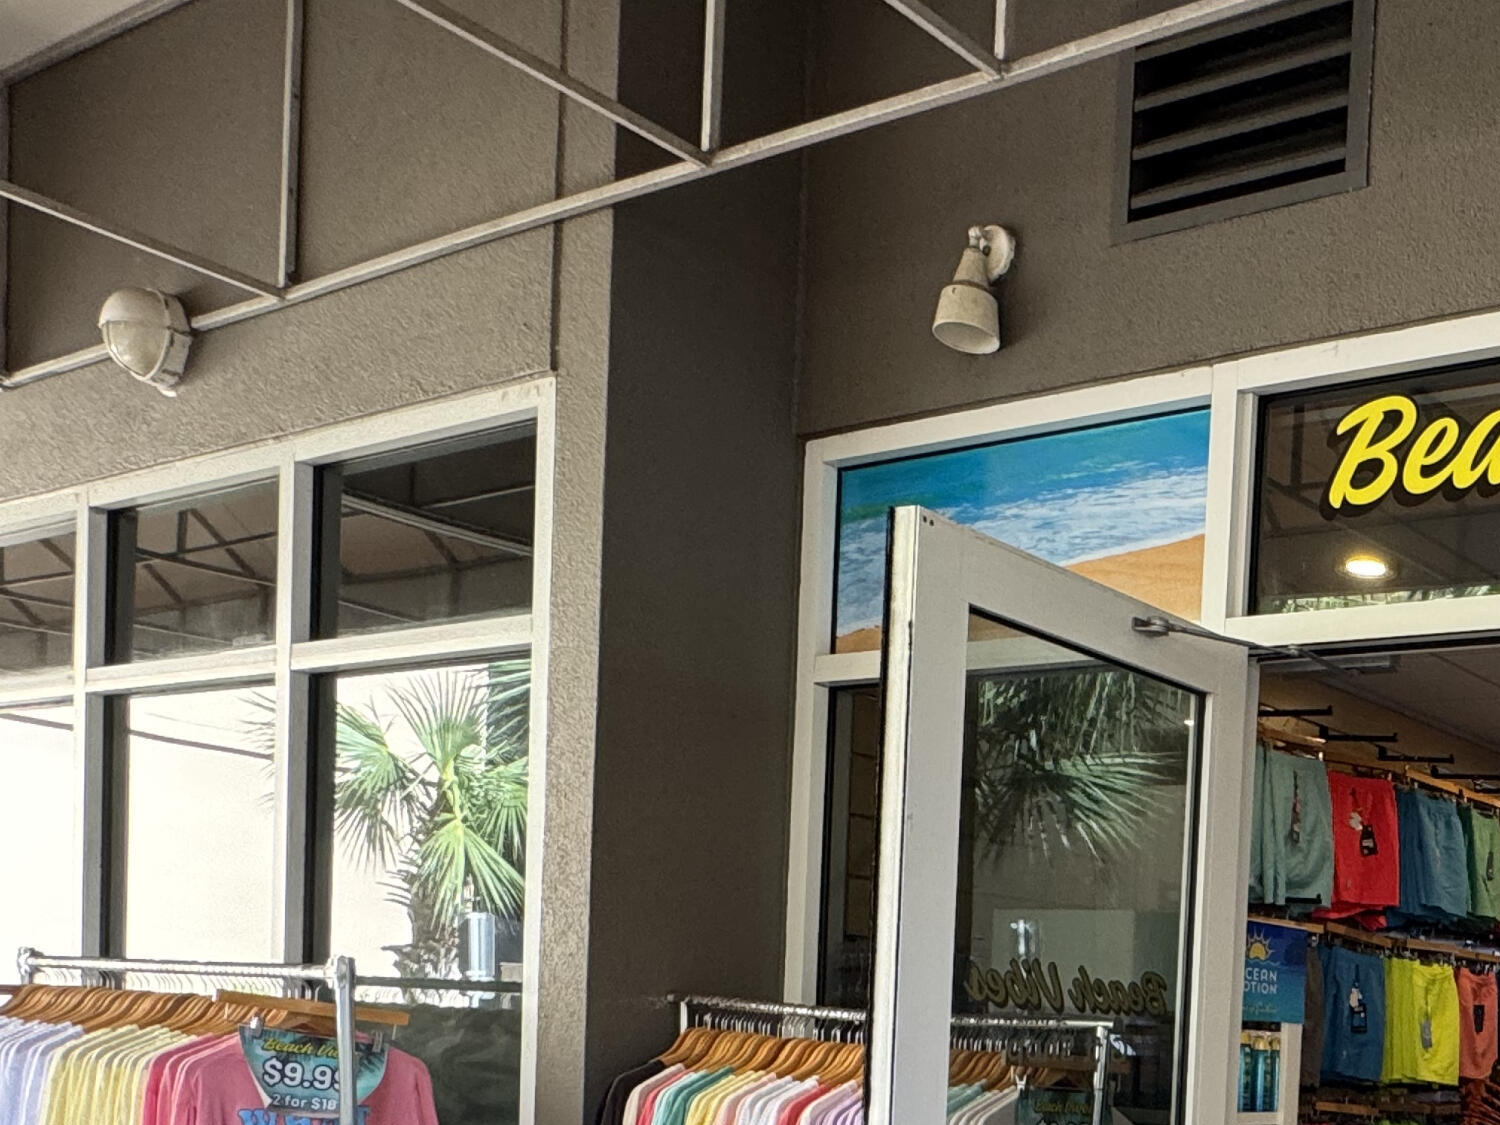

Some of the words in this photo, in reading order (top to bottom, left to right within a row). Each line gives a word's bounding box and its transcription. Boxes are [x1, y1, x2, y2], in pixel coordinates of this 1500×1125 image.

[1245, 967, 1277, 981] CEAN
[1244, 981, 1277, 994] OTION
[272, 1093, 282, 1106] 2
[284, 1094, 306, 1107] for
